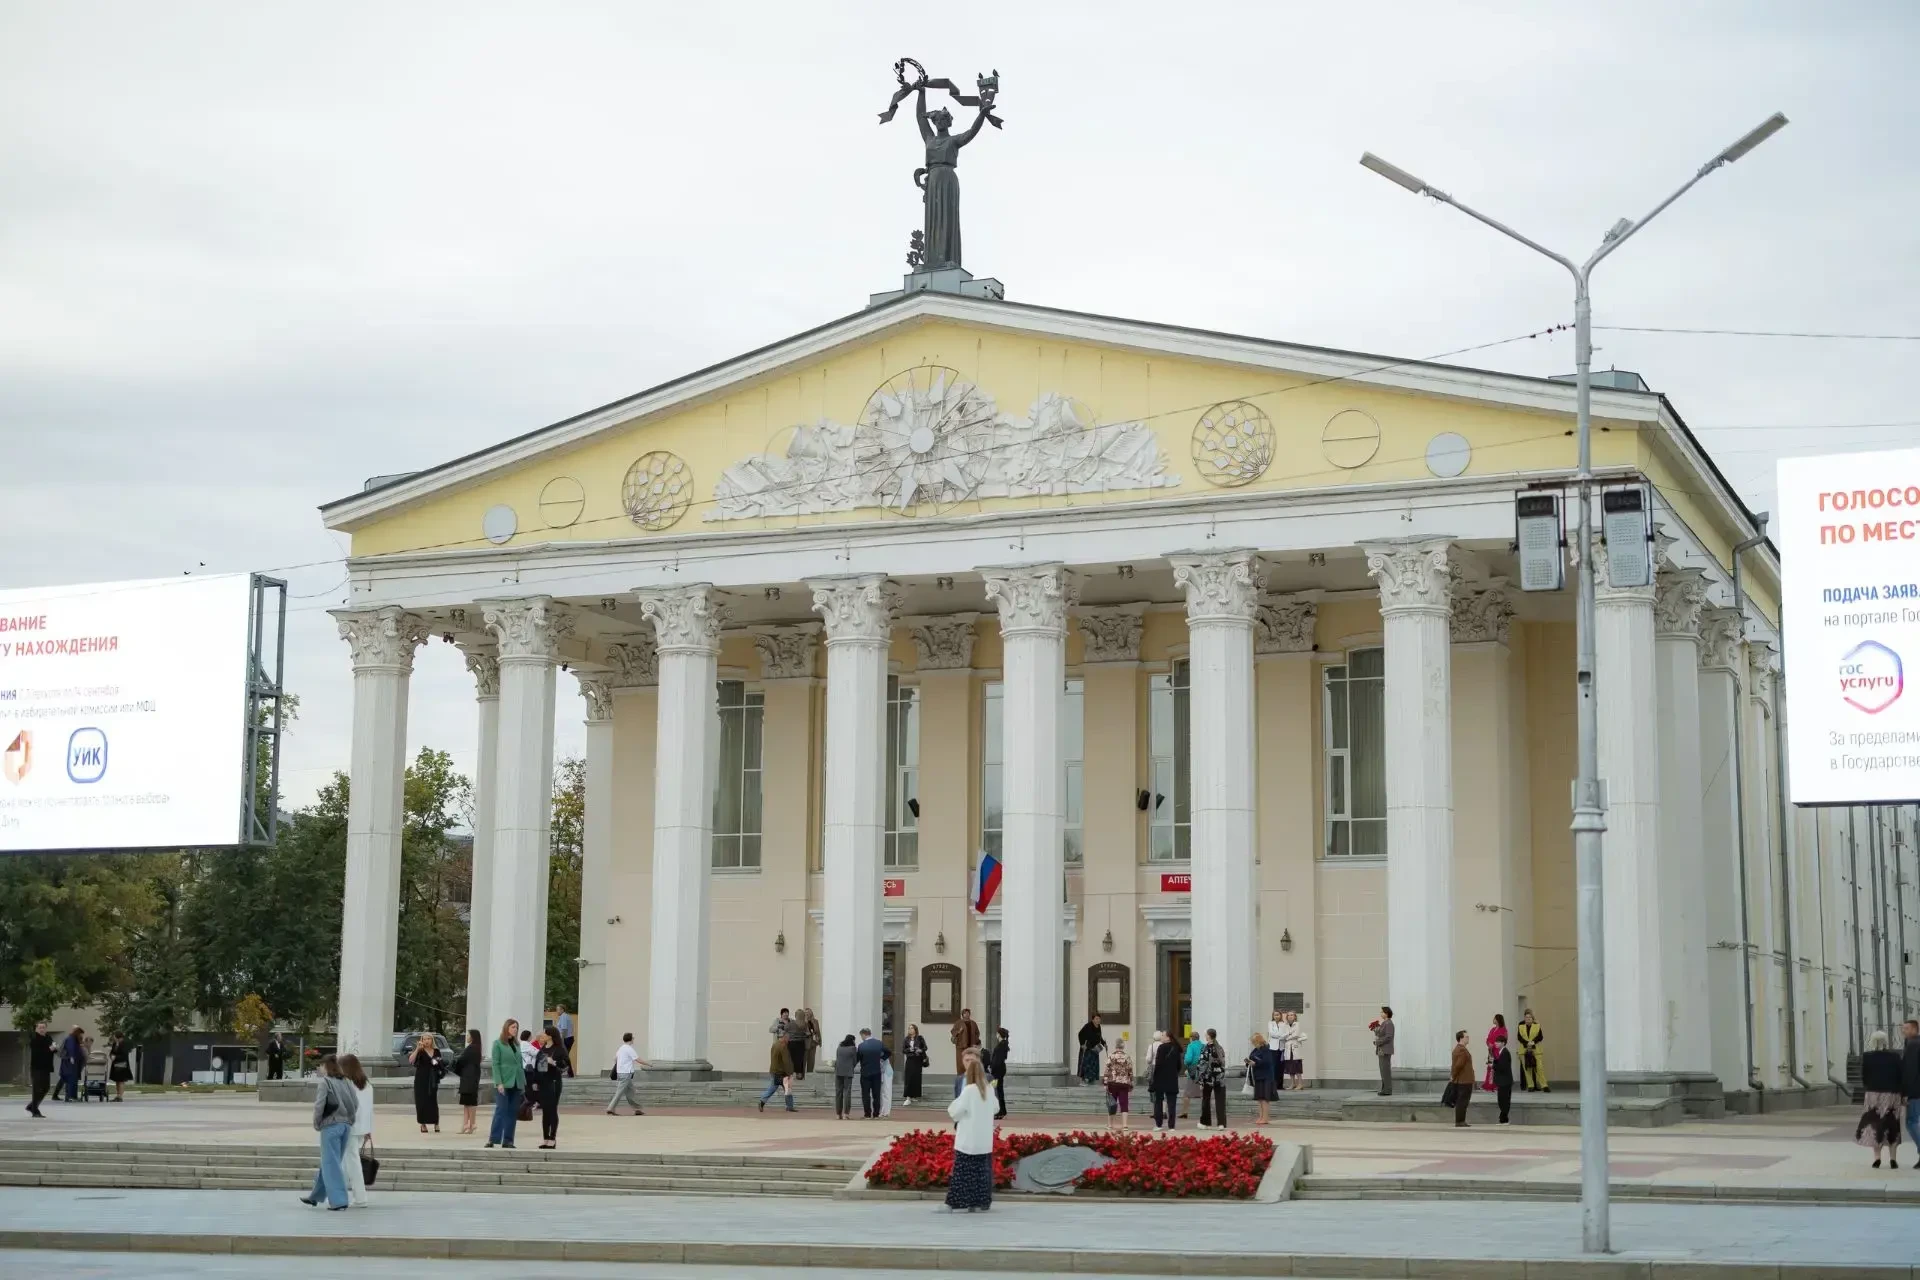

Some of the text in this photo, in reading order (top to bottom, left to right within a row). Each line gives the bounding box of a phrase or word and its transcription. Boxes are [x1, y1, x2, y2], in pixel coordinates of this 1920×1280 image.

[1820, 524, 1856, 545] ПО
[1823, 583, 1920, 604] ПОДАЧА ЗАЯВ
[0, 615, 47, 632] ВАНИЕ
[1824, 614, 1840, 627] на
[1844, 611, 1898, 628] портале
[16, 636, 118, 656] НАХОЖДЕНИЯ
[1839, 663, 1864, 676] гос
[1839, 676, 1895, 692] услуги
[1829, 730, 1845, 746] За
[73, 746, 101, 766] УИК
[1830, 758, 1838, 770] в
